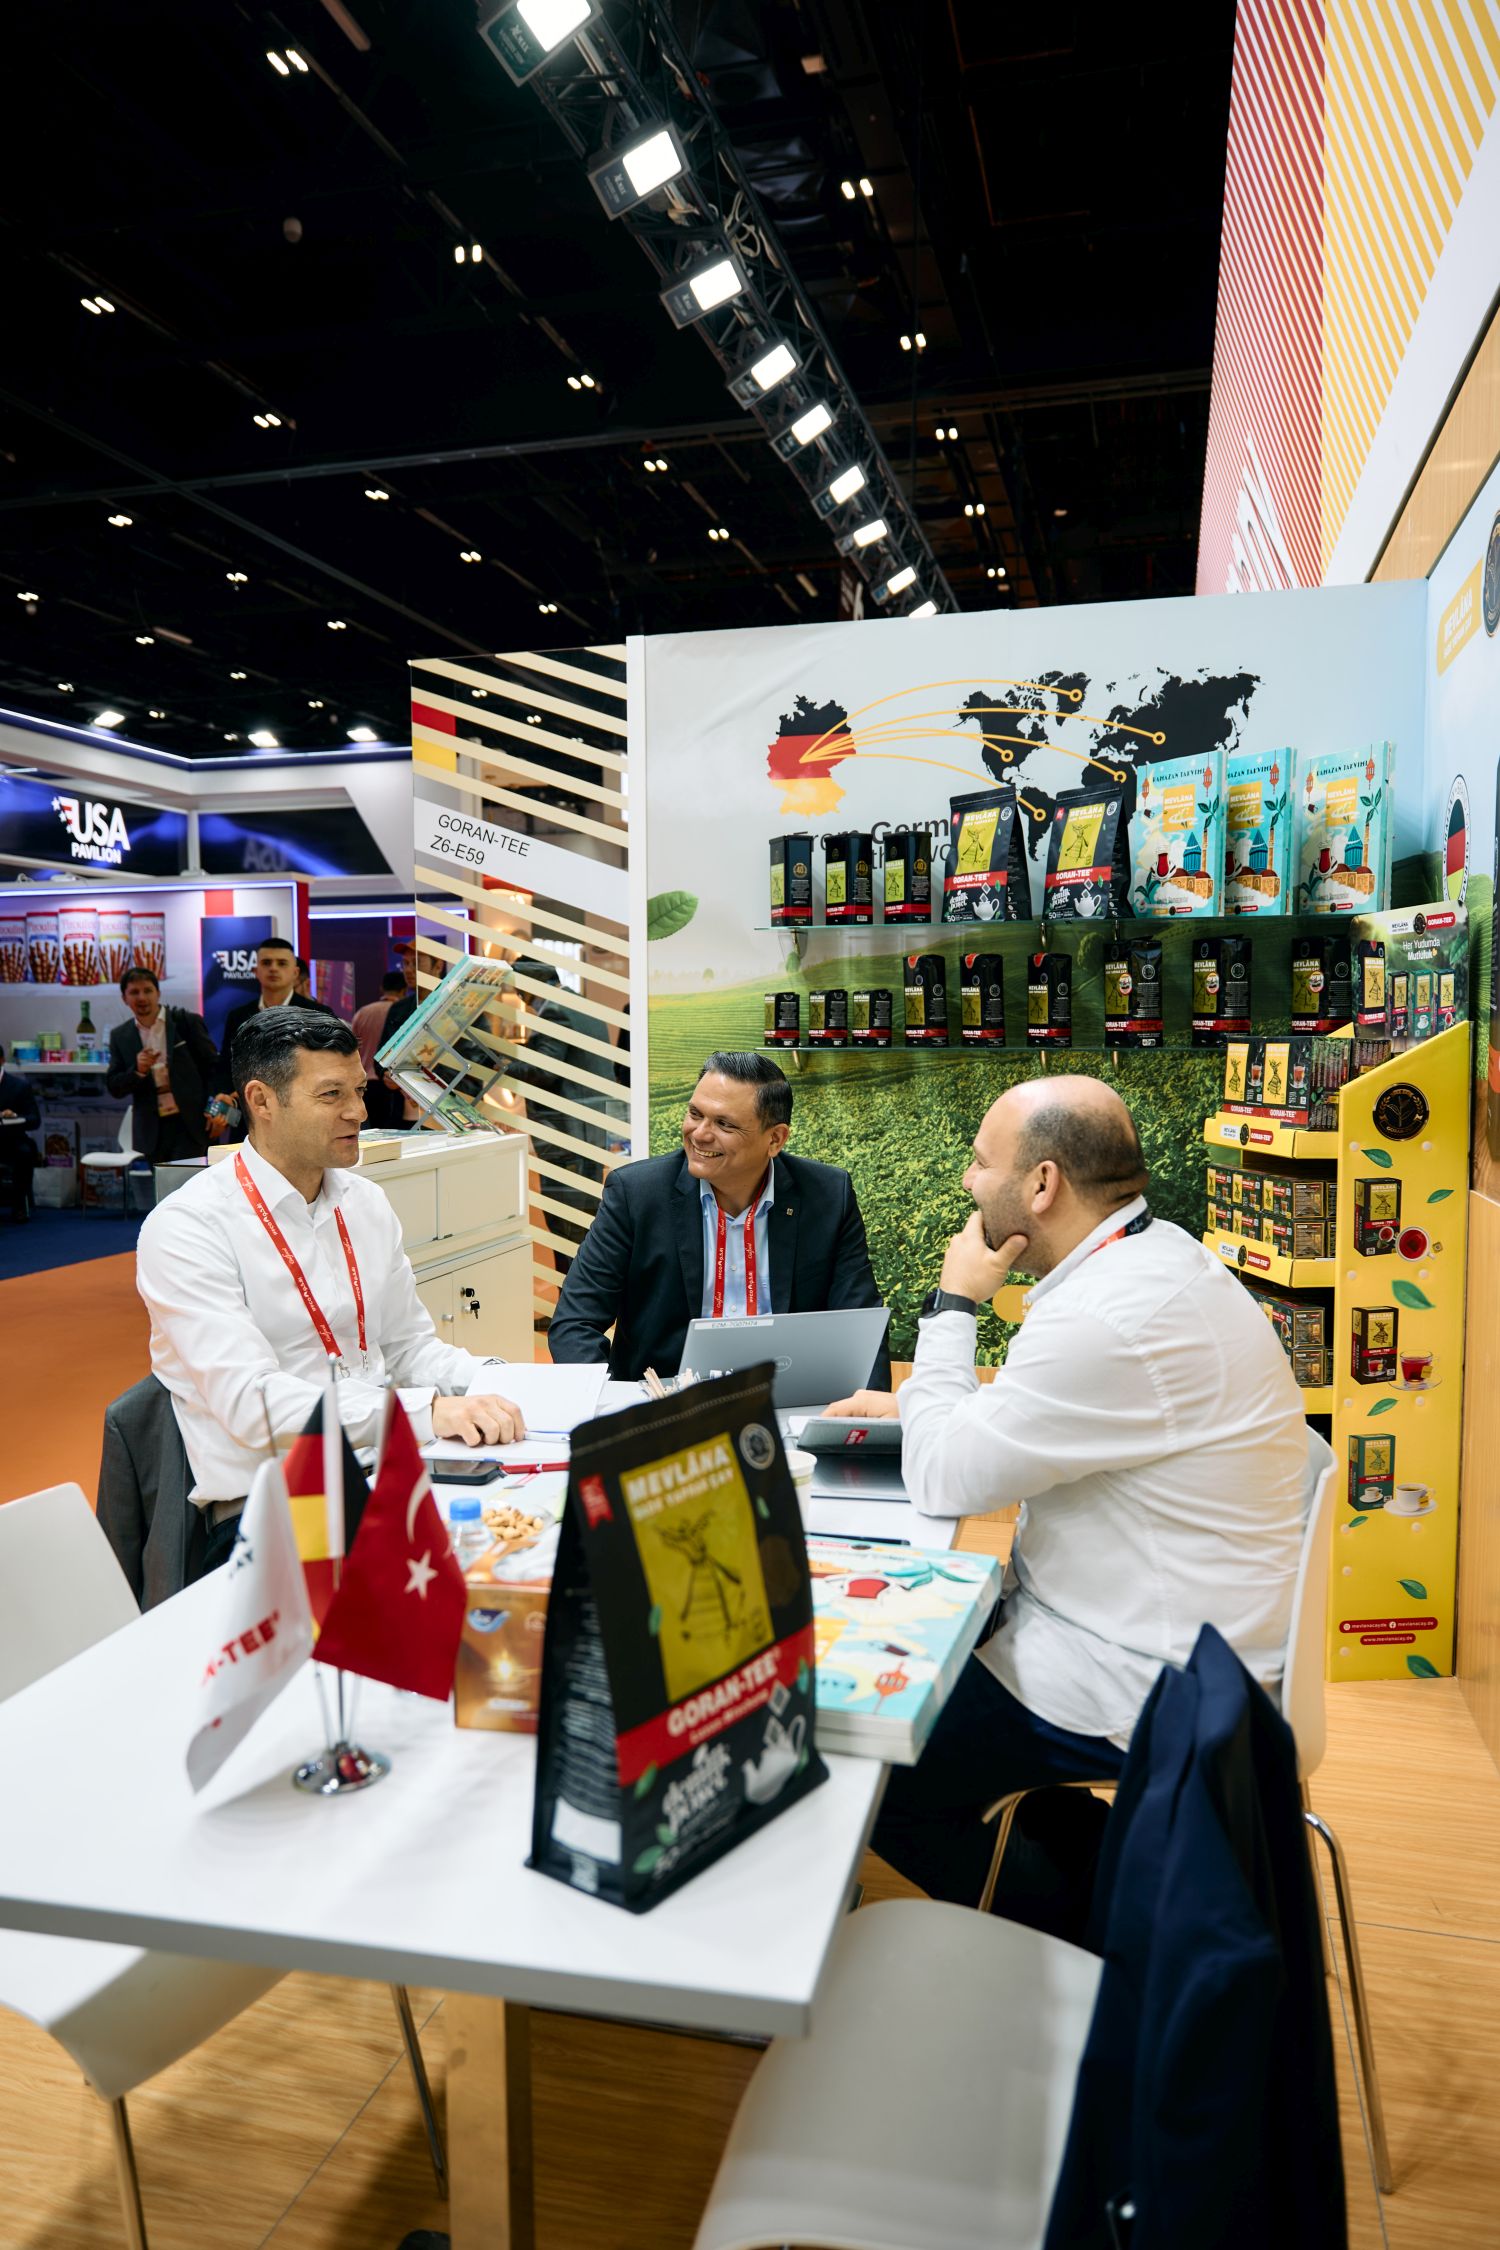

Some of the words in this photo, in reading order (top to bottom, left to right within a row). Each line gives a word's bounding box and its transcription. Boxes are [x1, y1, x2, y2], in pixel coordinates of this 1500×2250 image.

[58, 795, 131, 851] USA
[438, 814, 530, 857] GORAN-TEE
[71, 842, 122, 864] PAVILION
[430, 834, 485, 865] Z6-E59
[216, 950, 258, 973] USA
[666, 1647, 780, 1738] GORAN-TEE
